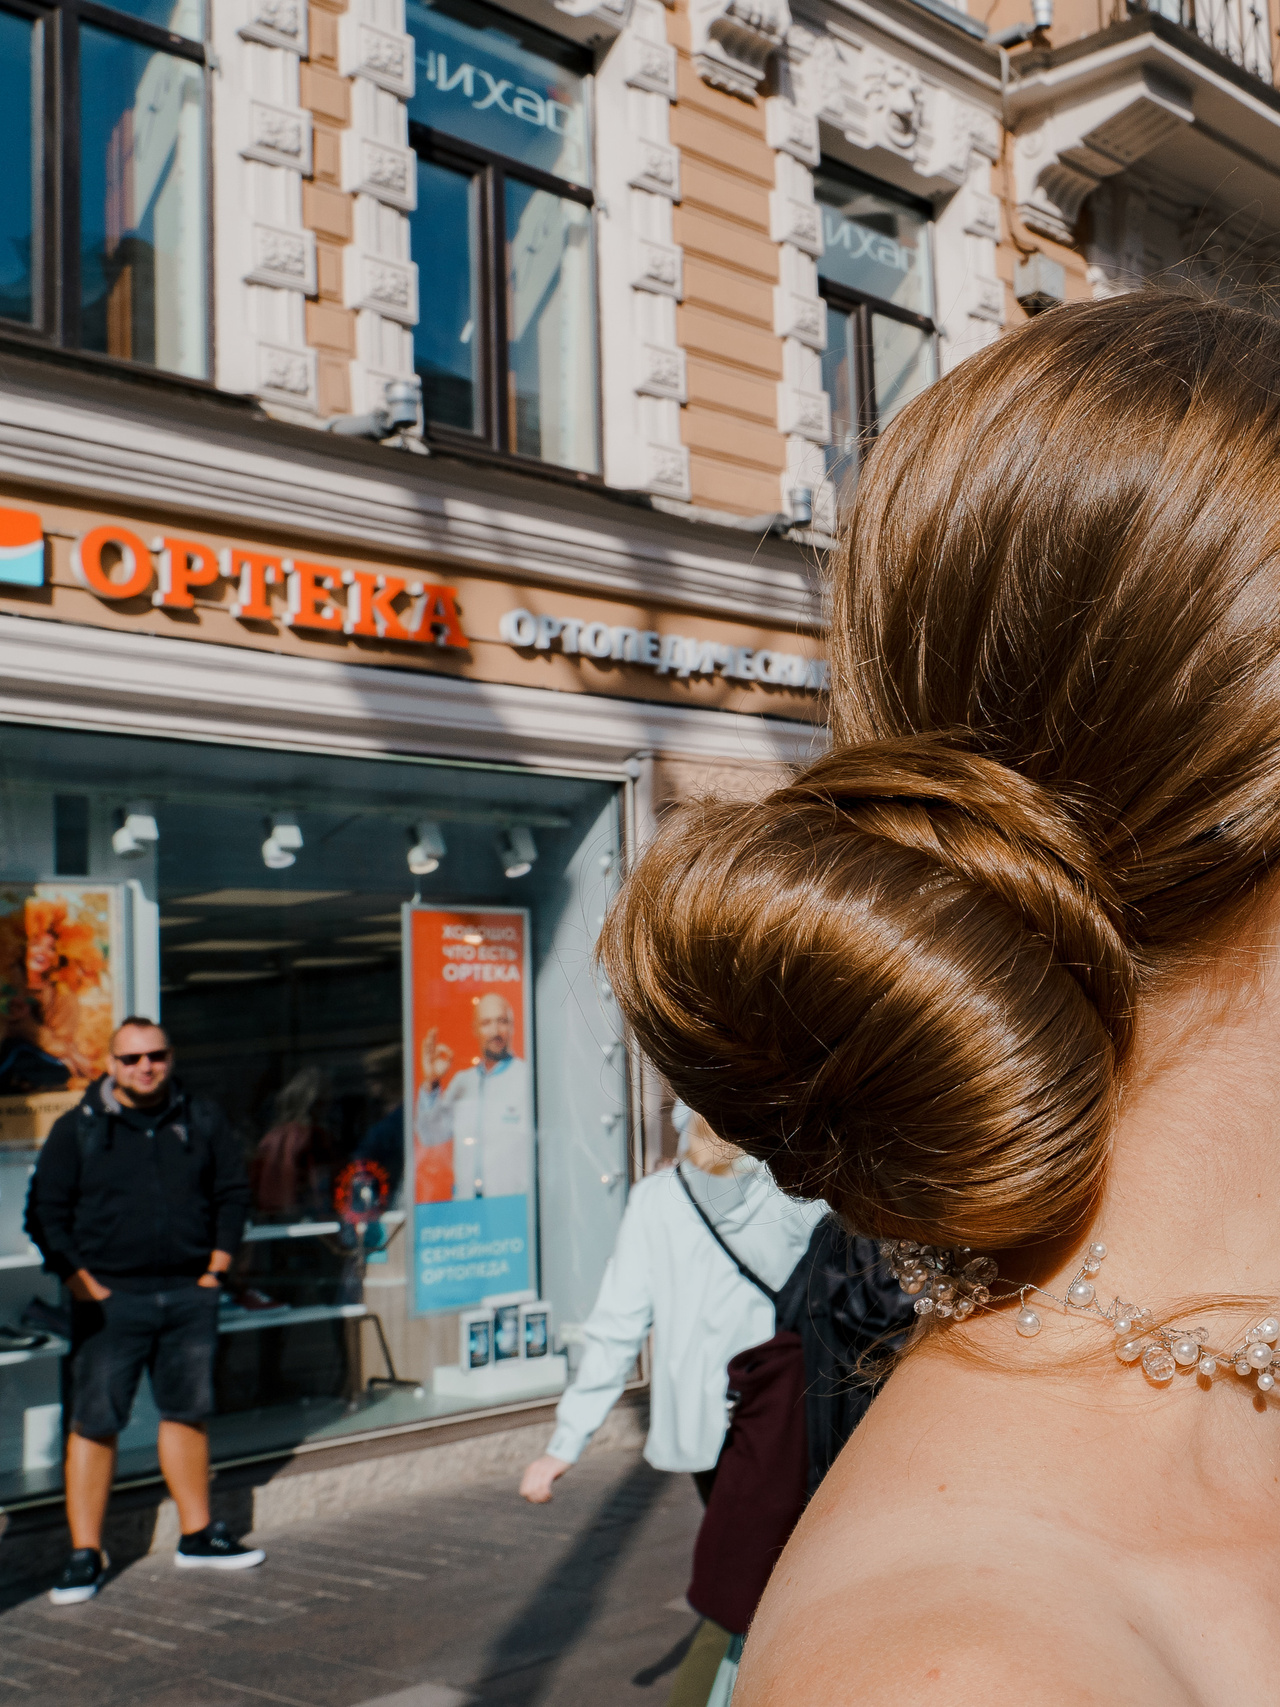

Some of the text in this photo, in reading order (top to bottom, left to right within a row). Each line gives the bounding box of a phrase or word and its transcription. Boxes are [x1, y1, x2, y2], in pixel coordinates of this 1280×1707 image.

[72, 524, 833, 691] ОРТЕКА ОРТОПЕДИЧЕСКИ
[441, 962, 521, 982] ОРТЕКА
[421, 1260, 511, 1285] ОРТОПЕДА
